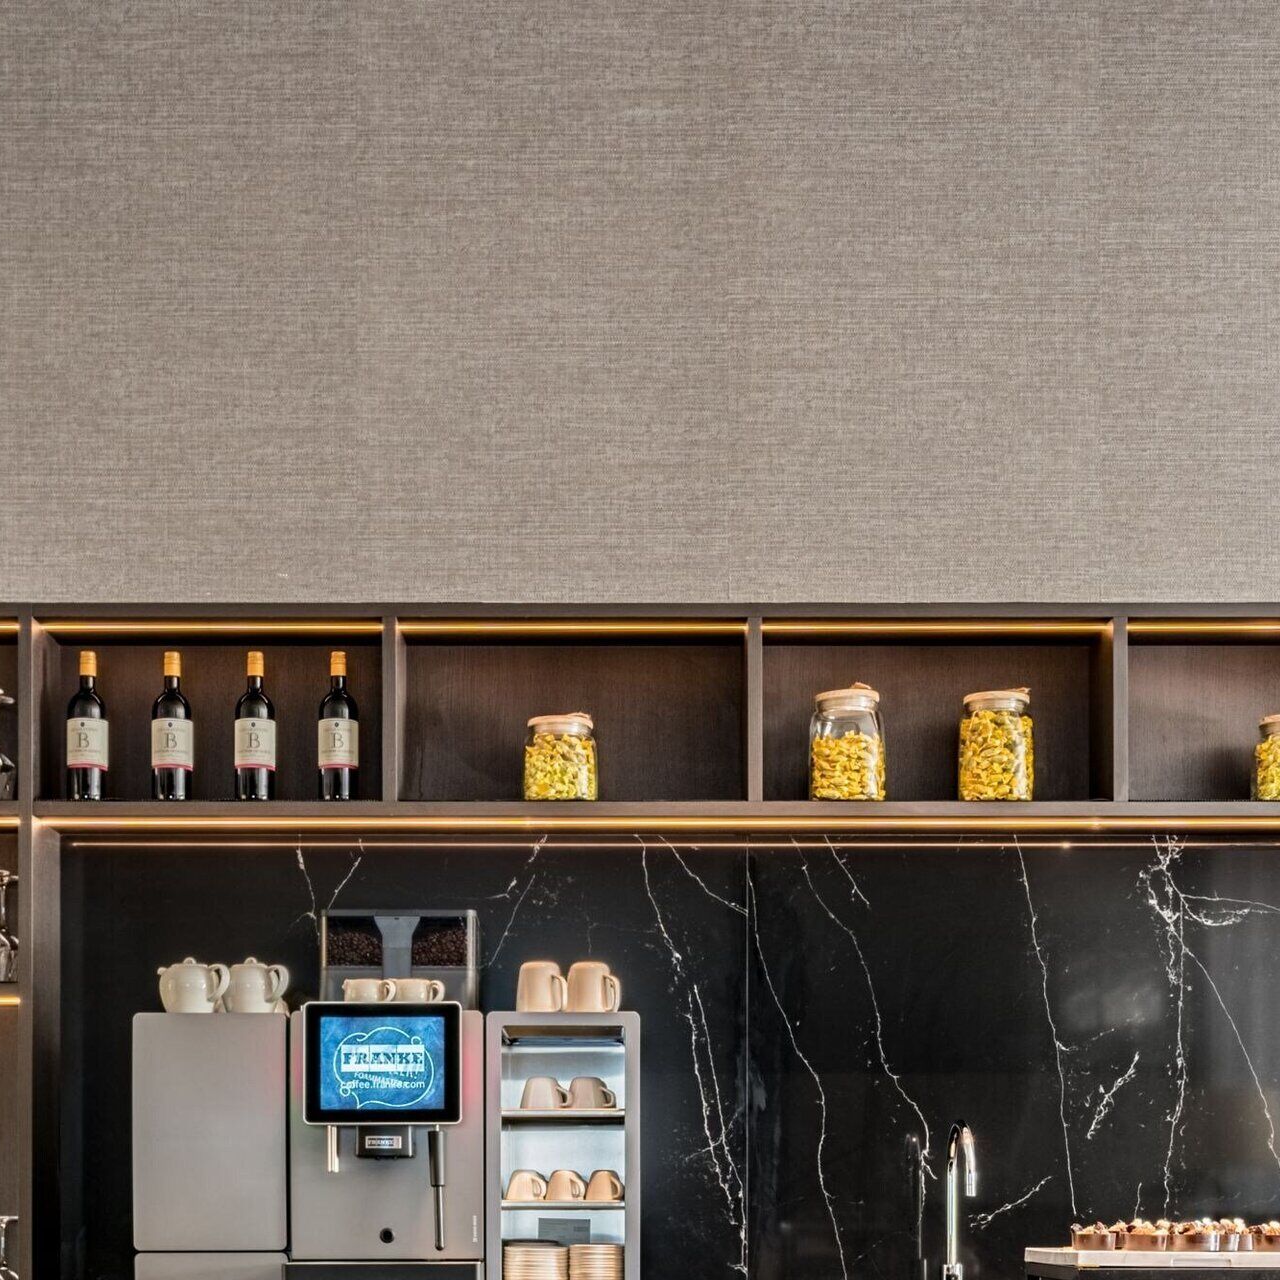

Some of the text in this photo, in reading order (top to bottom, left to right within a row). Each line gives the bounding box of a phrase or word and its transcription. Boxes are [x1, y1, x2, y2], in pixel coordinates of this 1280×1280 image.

[77, 732, 90, 748] B
[163, 732, 178, 749] B
[246, 732, 261, 749] B
[330, 732, 345, 749] B
[342, 1052, 424, 1065] FRANKE
